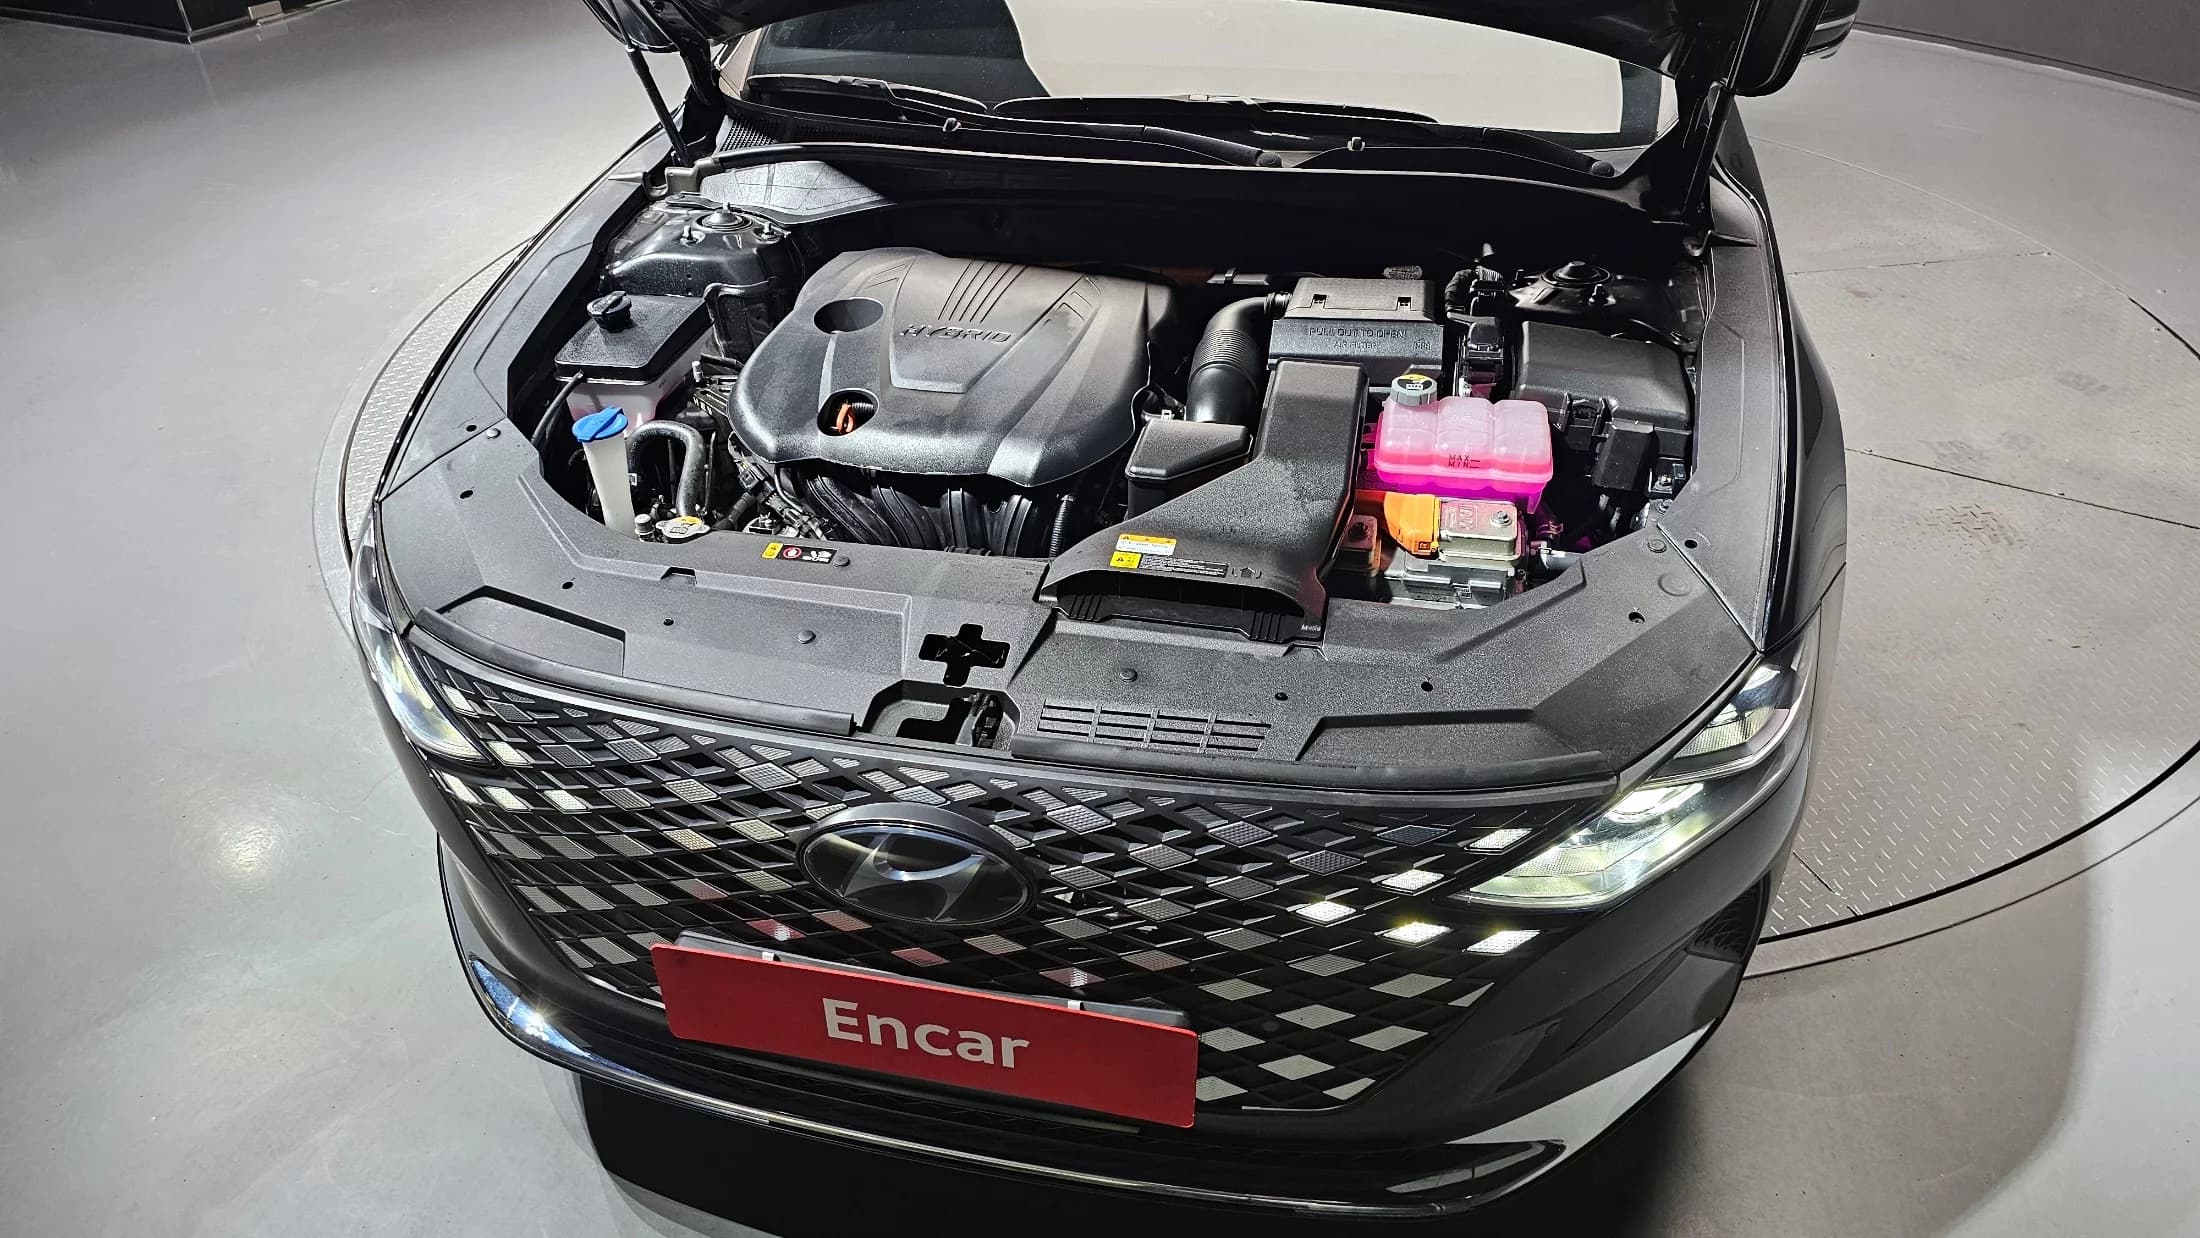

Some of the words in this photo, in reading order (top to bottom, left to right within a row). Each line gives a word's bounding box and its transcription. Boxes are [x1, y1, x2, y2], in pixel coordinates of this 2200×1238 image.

[900, 324, 1012, 344] HYBRID
[1337, 328, 1358, 338] OUT
[1361, 328, 1374, 338] TO
[1448, 461, 1469, 469] MIN
[822, 997, 1031, 1069] Encar
